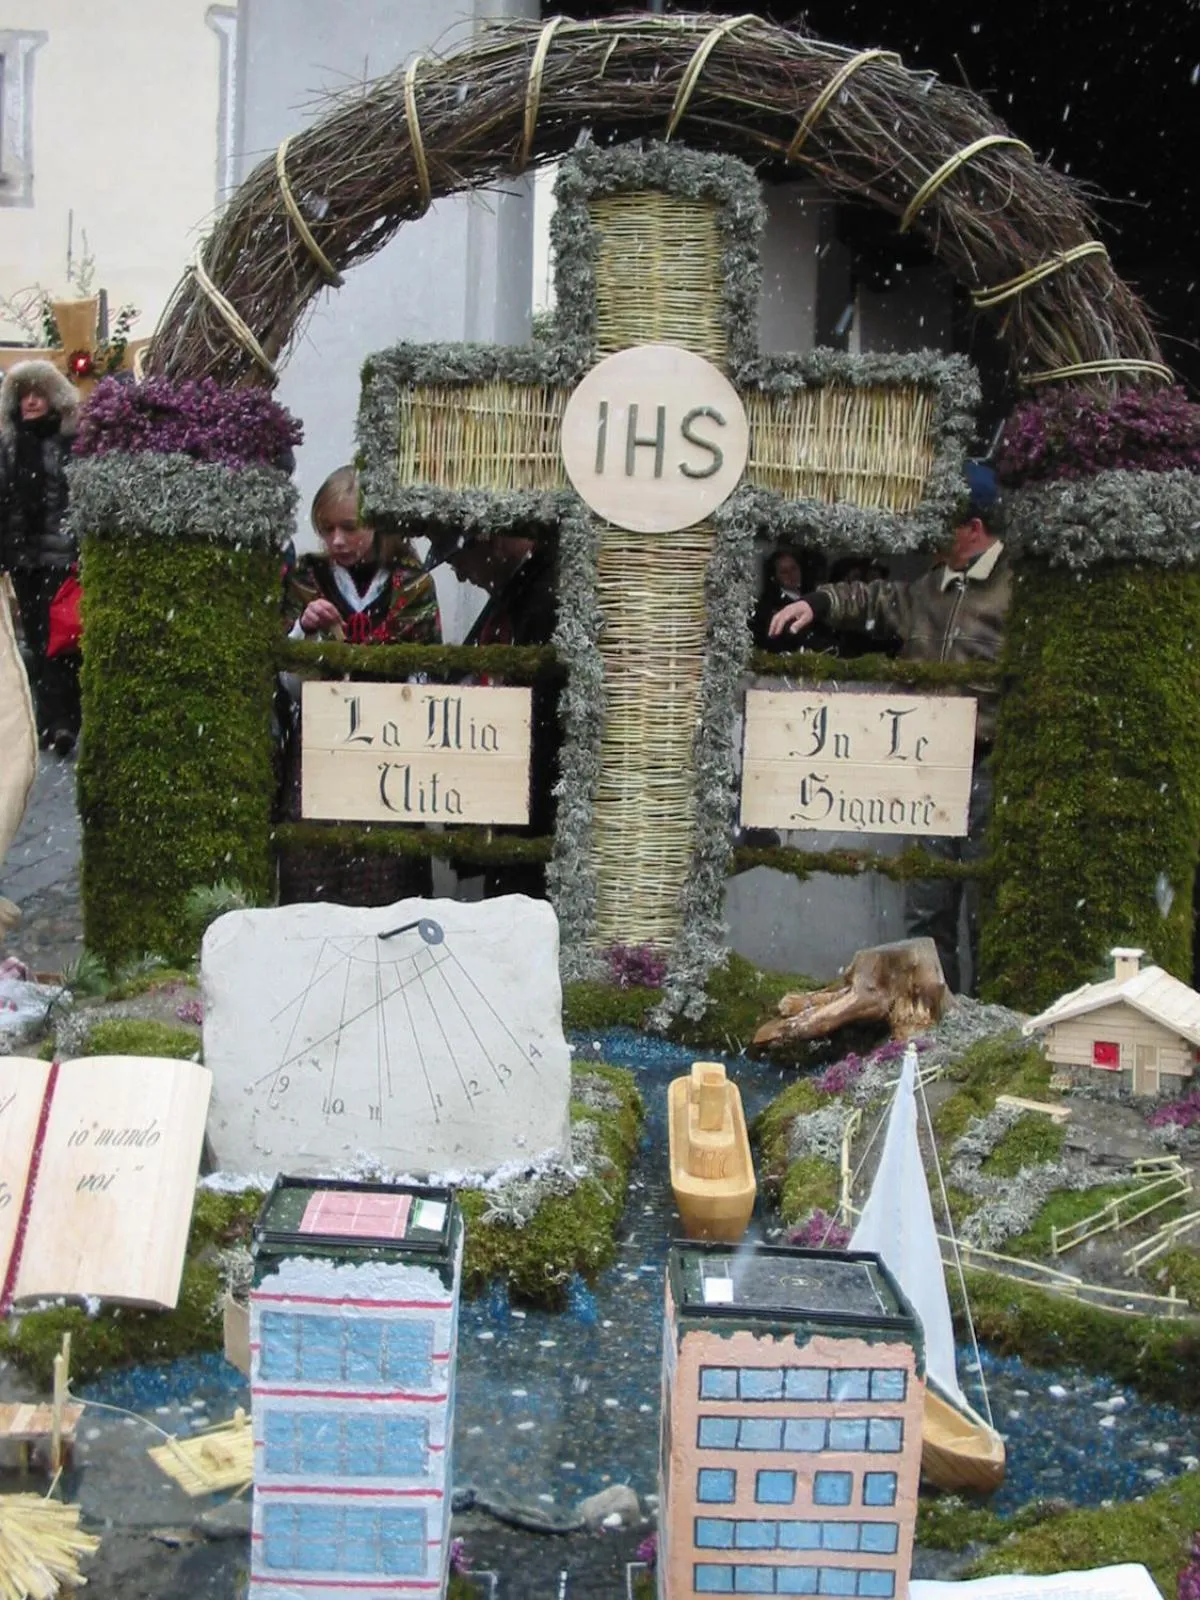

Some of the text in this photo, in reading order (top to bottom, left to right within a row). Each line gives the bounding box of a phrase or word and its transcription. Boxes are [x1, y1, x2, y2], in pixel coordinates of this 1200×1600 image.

[595, 401, 727, 479] IHS
[343, 695, 500, 751] La Mia
[788, 704, 850, 759] In
[279, 1075, 291, 1093] 9
[94, 1118, 162, 1147] mando
